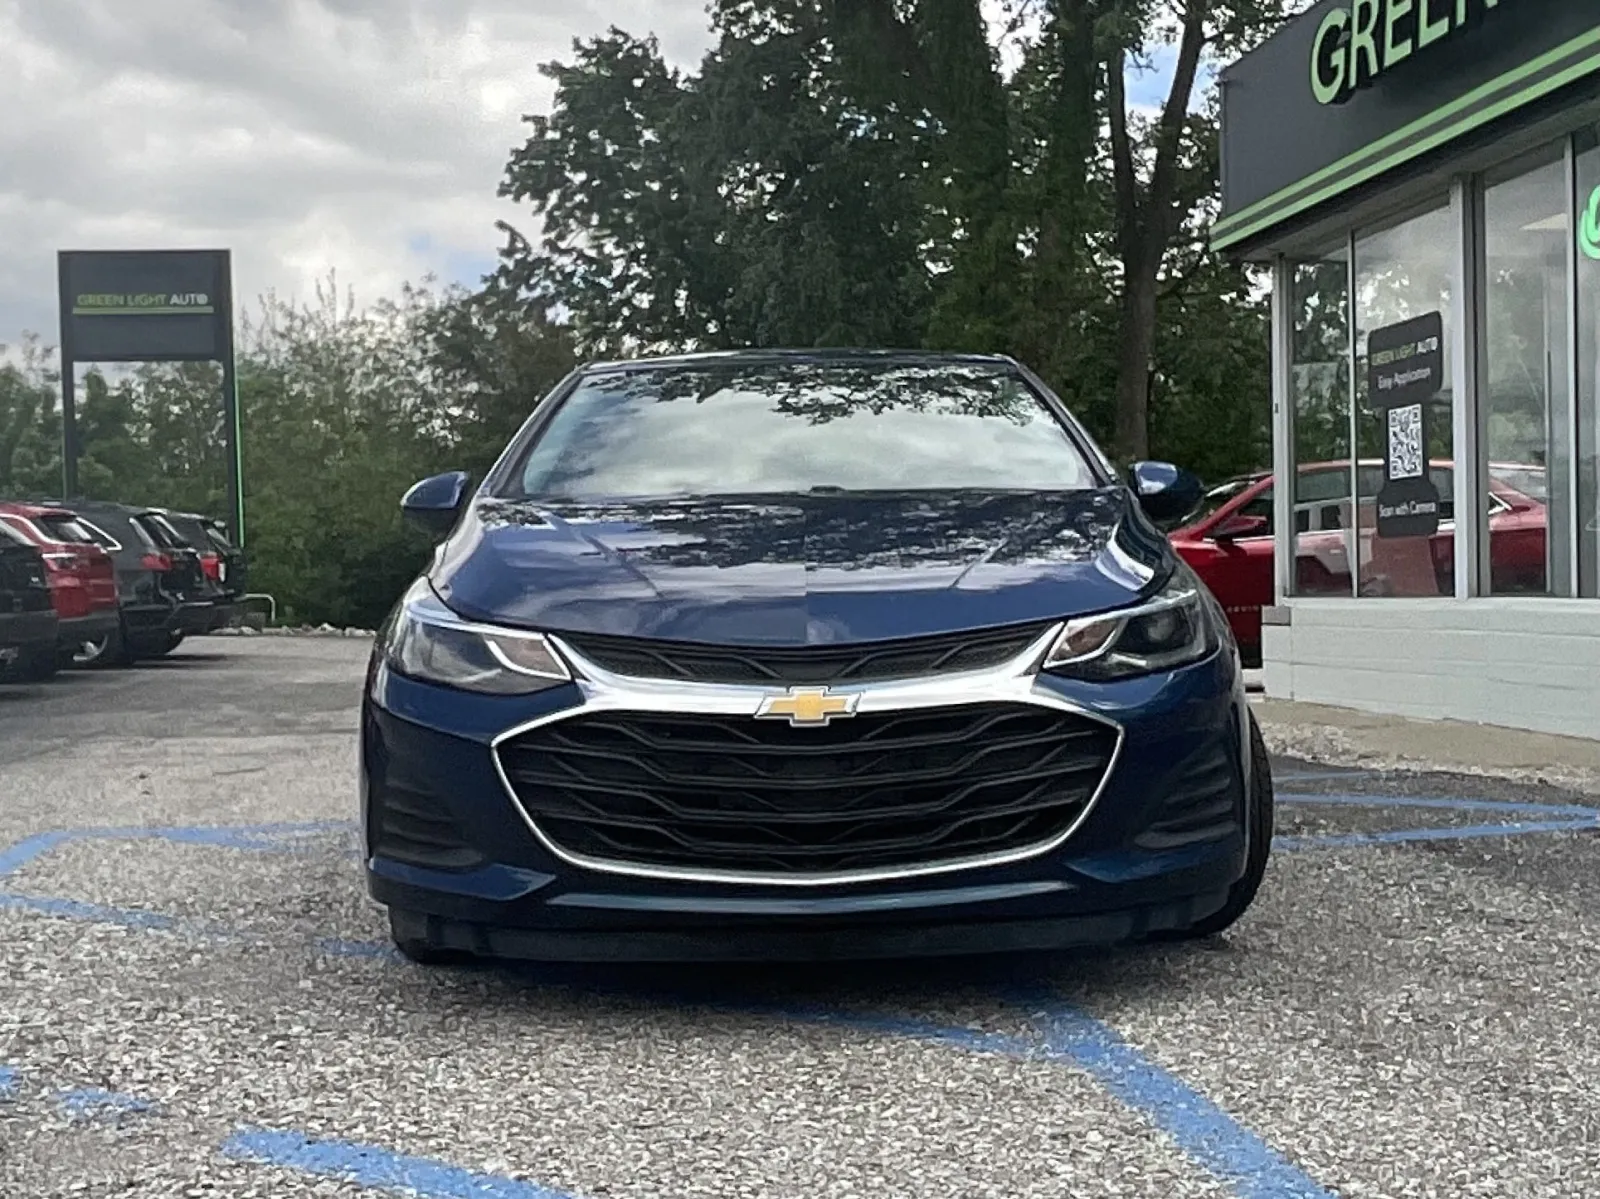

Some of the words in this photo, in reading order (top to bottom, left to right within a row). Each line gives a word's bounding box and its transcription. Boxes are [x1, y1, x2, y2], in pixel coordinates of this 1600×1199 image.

[1311, 0, 1498, 104] GRE
[77, 294, 124, 306] GREEN
[126, 294, 167, 306] LIGHT
[169, 293, 208, 305] AUTO
